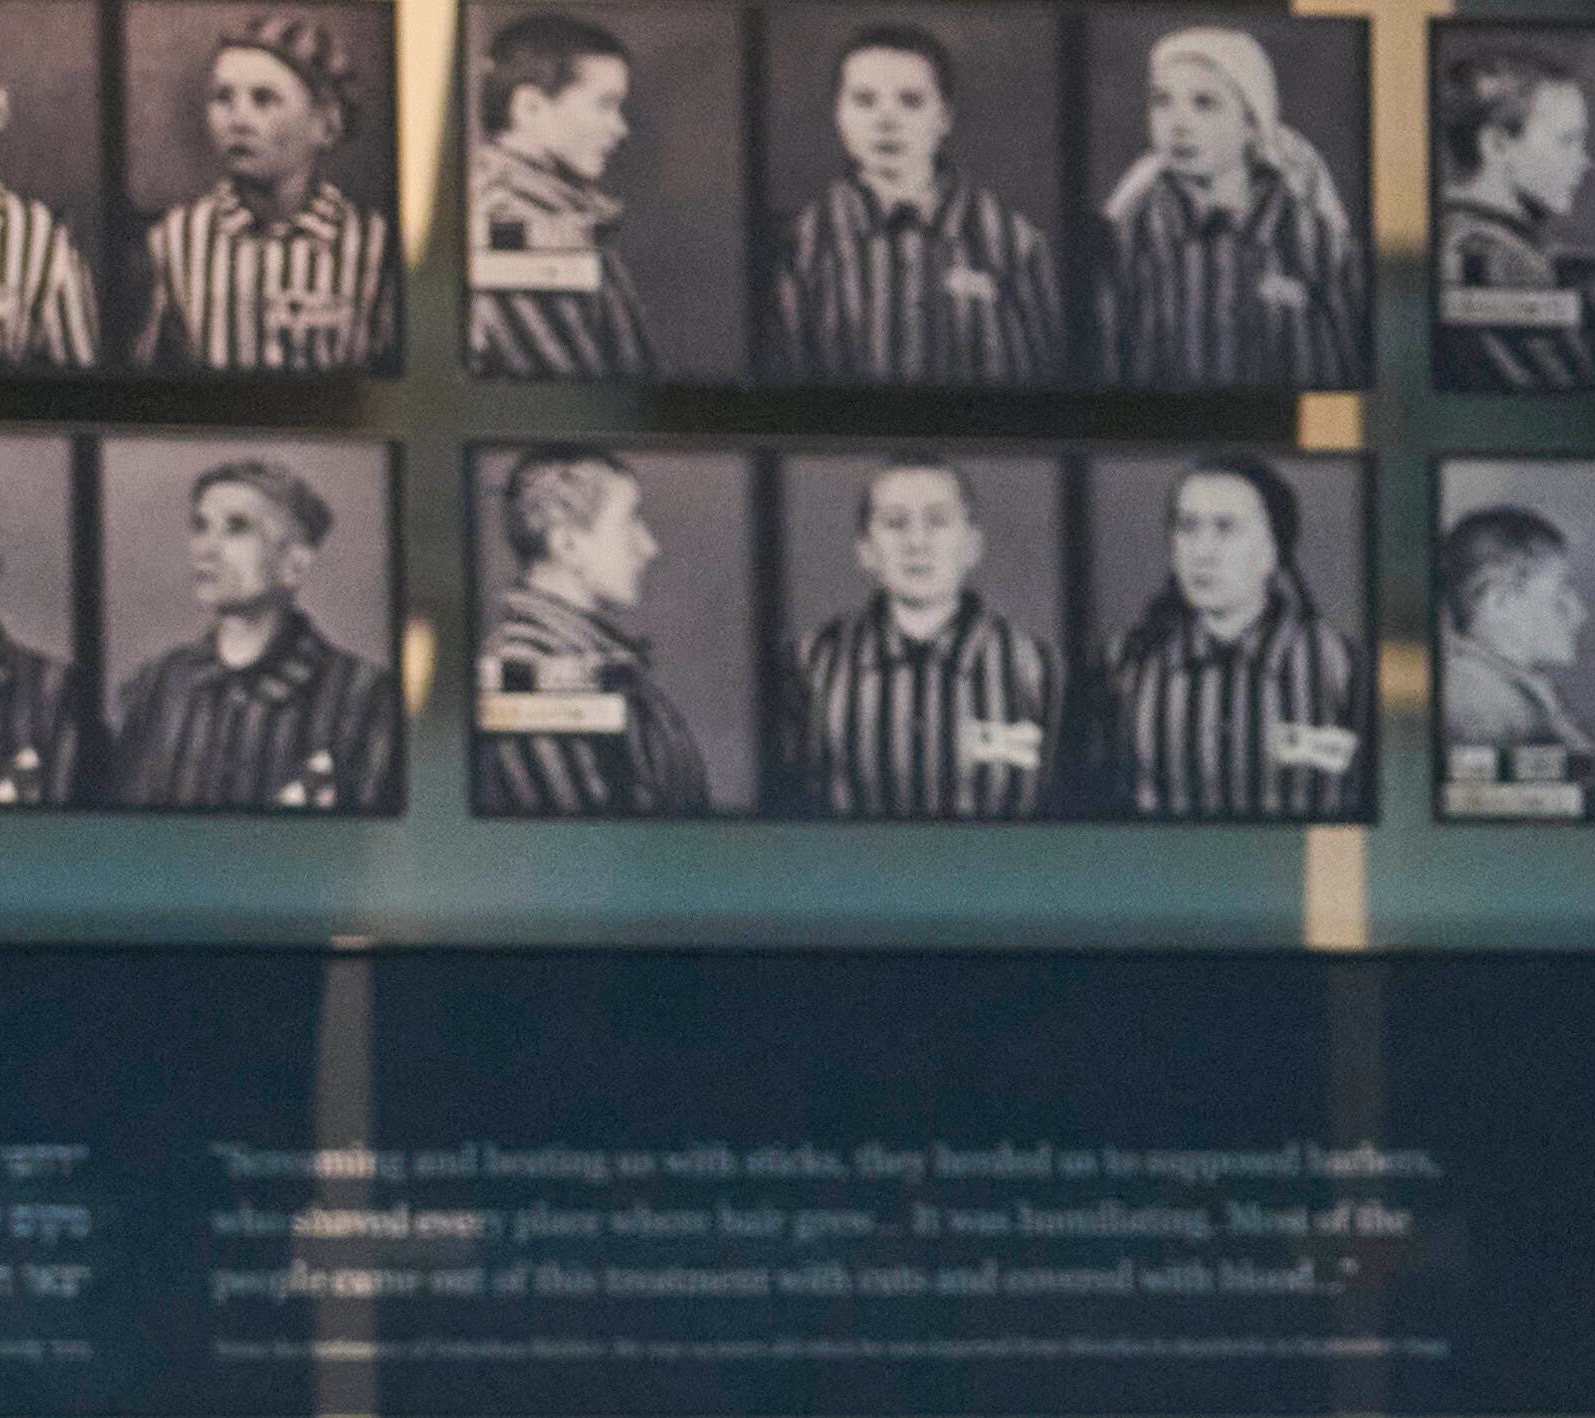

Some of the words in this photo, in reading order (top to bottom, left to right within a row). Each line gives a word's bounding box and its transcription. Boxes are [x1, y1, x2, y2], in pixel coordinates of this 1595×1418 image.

[414, 1141, 477, 1178] and
[661, 1141, 736, 1178] with
[716, 1200, 785, 1237] hair
[1356, 1200, 1413, 1237] the
[775, 1259, 853, 1296] with
[936, 1259, 999, 1296] and
[1139, 1259, 1215, 1296] with
